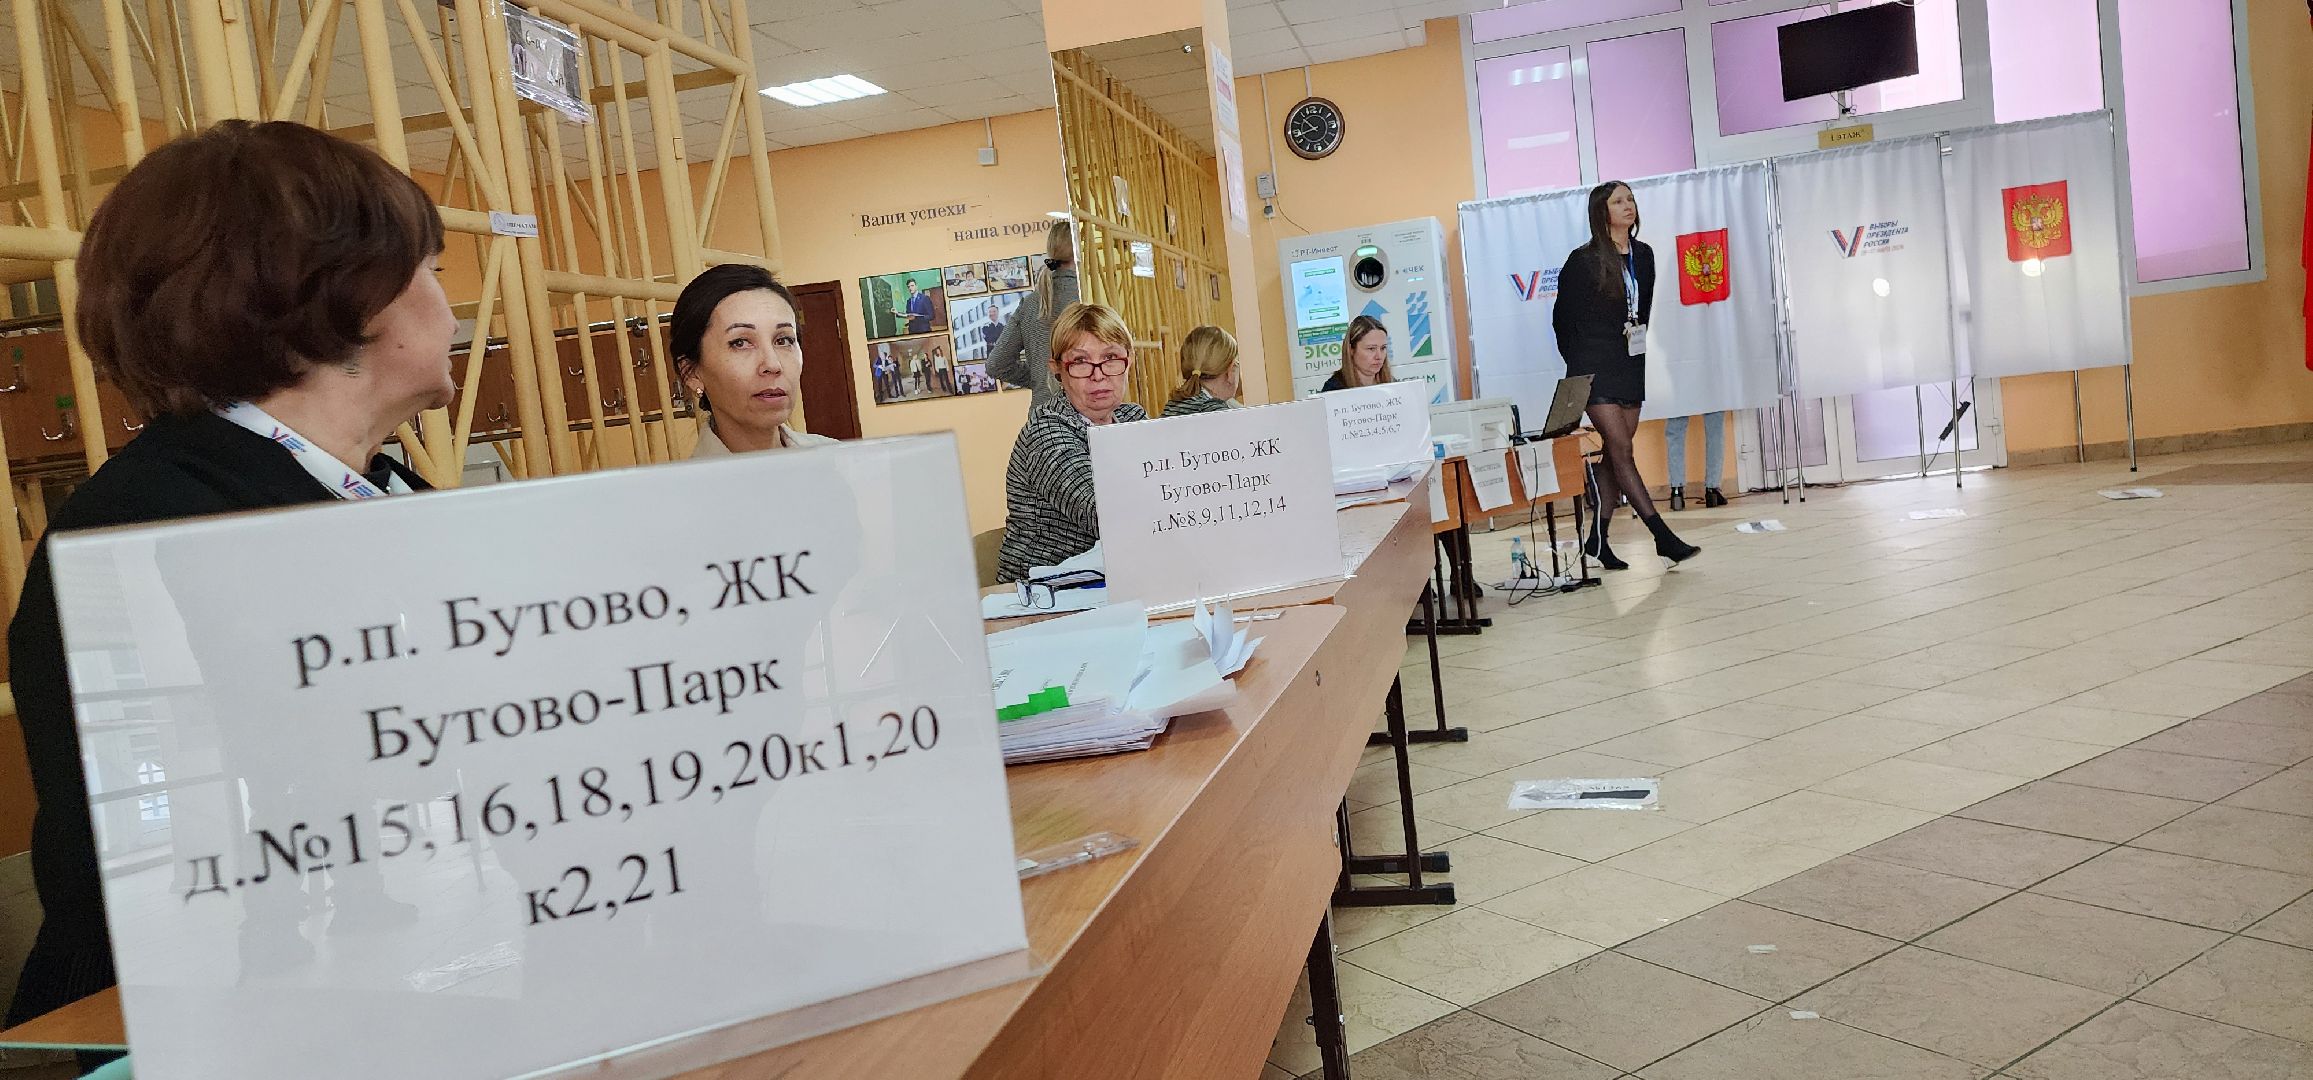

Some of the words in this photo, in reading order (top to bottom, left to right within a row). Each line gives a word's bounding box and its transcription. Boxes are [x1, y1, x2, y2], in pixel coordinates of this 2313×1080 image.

[1305, 105, 1318, 115] 12
[1836, 131, 1862, 141] ЭТАЖ
[861, 211, 906, 229] Ваши
[909, 203, 967, 226] успехи
[953, 225, 1000, 242] наша
[1304, 343, 1342, 359] ЭКО
[1386, 396, 1402, 407] ЖК
[1342, 412, 1398, 428] Бутово-Парк
[1142, 459, 1175, 478] р.п.
[1179, 447, 1246, 471] Бутово,
[1249, 437, 1282, 458] ЖК
[1160, 472, 1272, 503] Бутово-Парк
[1152, 495, 1287, 535] д.№8,9,11,12,14
[291, 621, 419, 688] р.п.
[445, 582, 691, 656] Бутово,
[705, 549, 818, 611] ЖК
[366, 656, 784, 768] Бутово-Парк
[183, 703, 942, 905] д.№15,16,18,19,20к1,20
[525, 845, 687, 927] к2,21
